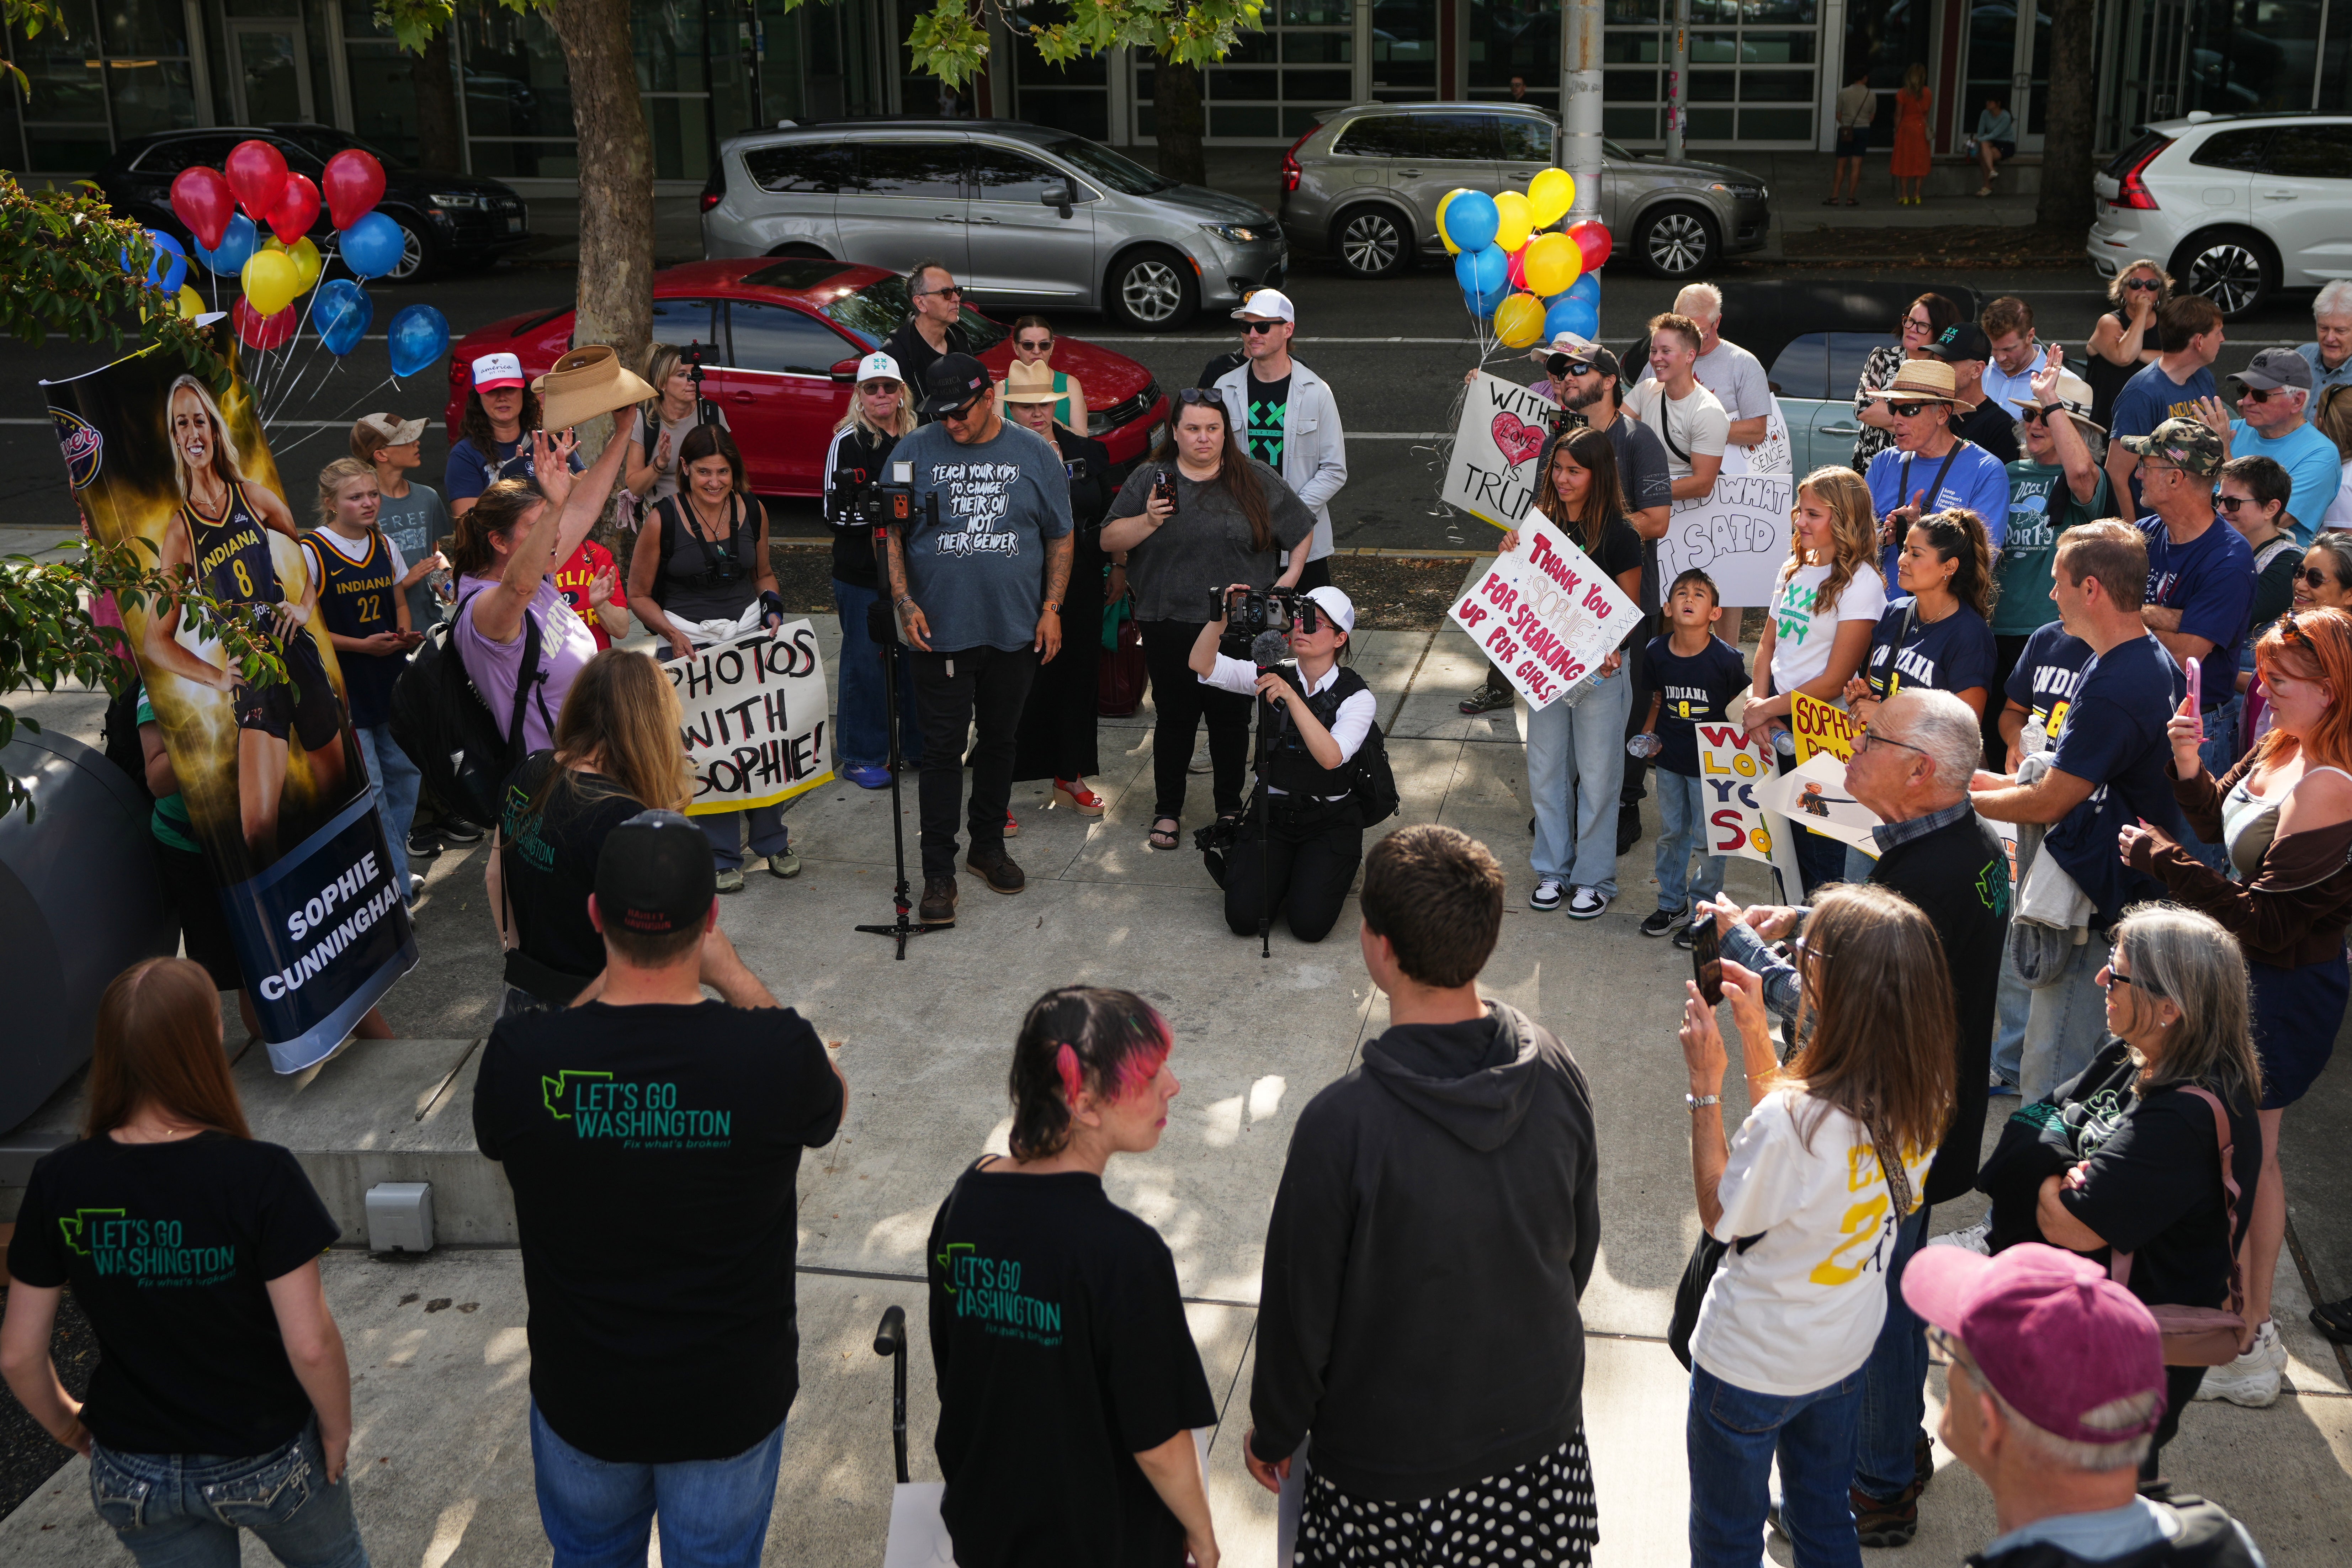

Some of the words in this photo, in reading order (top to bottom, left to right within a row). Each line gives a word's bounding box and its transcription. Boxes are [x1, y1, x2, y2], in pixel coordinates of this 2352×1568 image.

[481, 363, 513, 373] america
[1490, 381, 1550, 425] WITH
[1500, 424, 1539, 453] LOVE
[1740, 425, 1785, 459] COMMON
[932, 464, 966, 482] TEACH
[969, 463, 994, 481] YOUR
[1502, 463, 1522, 482] IS
[1752, 443, 1786, 471] SENSE
[950, 481, 963, 496] TO
[966, 481, 1003, 495] CHANGE
[1464, 463, 1533, 520] TRUT
[1718, 478, 1790, 514] WHAT
[1942, 494, 1962, 503] women's
[234, 513, 249, 523] Lilly
[378, 511, 425, 532] FREE
[966, 510, 997, 533] NOT
[201, 529, 260, 576] INDIANA
[973, 532, 1017, 552] GENDER
[1684, 515, 1775, 568] SAID
[233, 559, 253, 597] 8
[336, 576, 392, 594] INDIANA
[1529, 532, 1582, 595] THANK
[1582, 583, 1612, 619] YOU
[357, 595, 381, 623] 22
[1524, 576, 1594, 648] SOPHIE
[1459, 598, 1487, 628] UP
[1485, 626, 1519, 664] FOR
[1481, 572, 1518, 613] FOR
[1507, 604, 1585, 681] SPEAKING
[664, 629, 815, 699] PHOTOS
[1870, 644, 1935, 687] INIANA
[1665, 685, 1709, 703] INDIANA
[2033, 666, 2079, 698] INDI
[680, 688, 787, 751] WITH
[1679, 701, 1690, 718] 8
[1796, 697, 1868, 742] SOPHI
[684, 721, 825, 798] SOPHIE!
[1706, 778, 1760, 809] YO
[288, 850, 379, 941] SOPHIE
[577, 1083, 638, 1111] LET'S
[646, 1083, 676, 1110] GO
[576, 1110, 731, 1139] WASHINGTON
[623, 1139, 641, 1149] Fix
[644, 1139, 683, 1148] what's
[686, 1139, 731, 1149] broken!
[90, 1219, 149, 1248] LET'S
[154, 1219, 182, 1247] GO
[92, 1245, 235, 1277] WASHINGTON
[955, 1256, 994, 1290] LET'S
[998, 1259, 1021, 1293] GO
[137, 1277, 155, 1288] Fix
